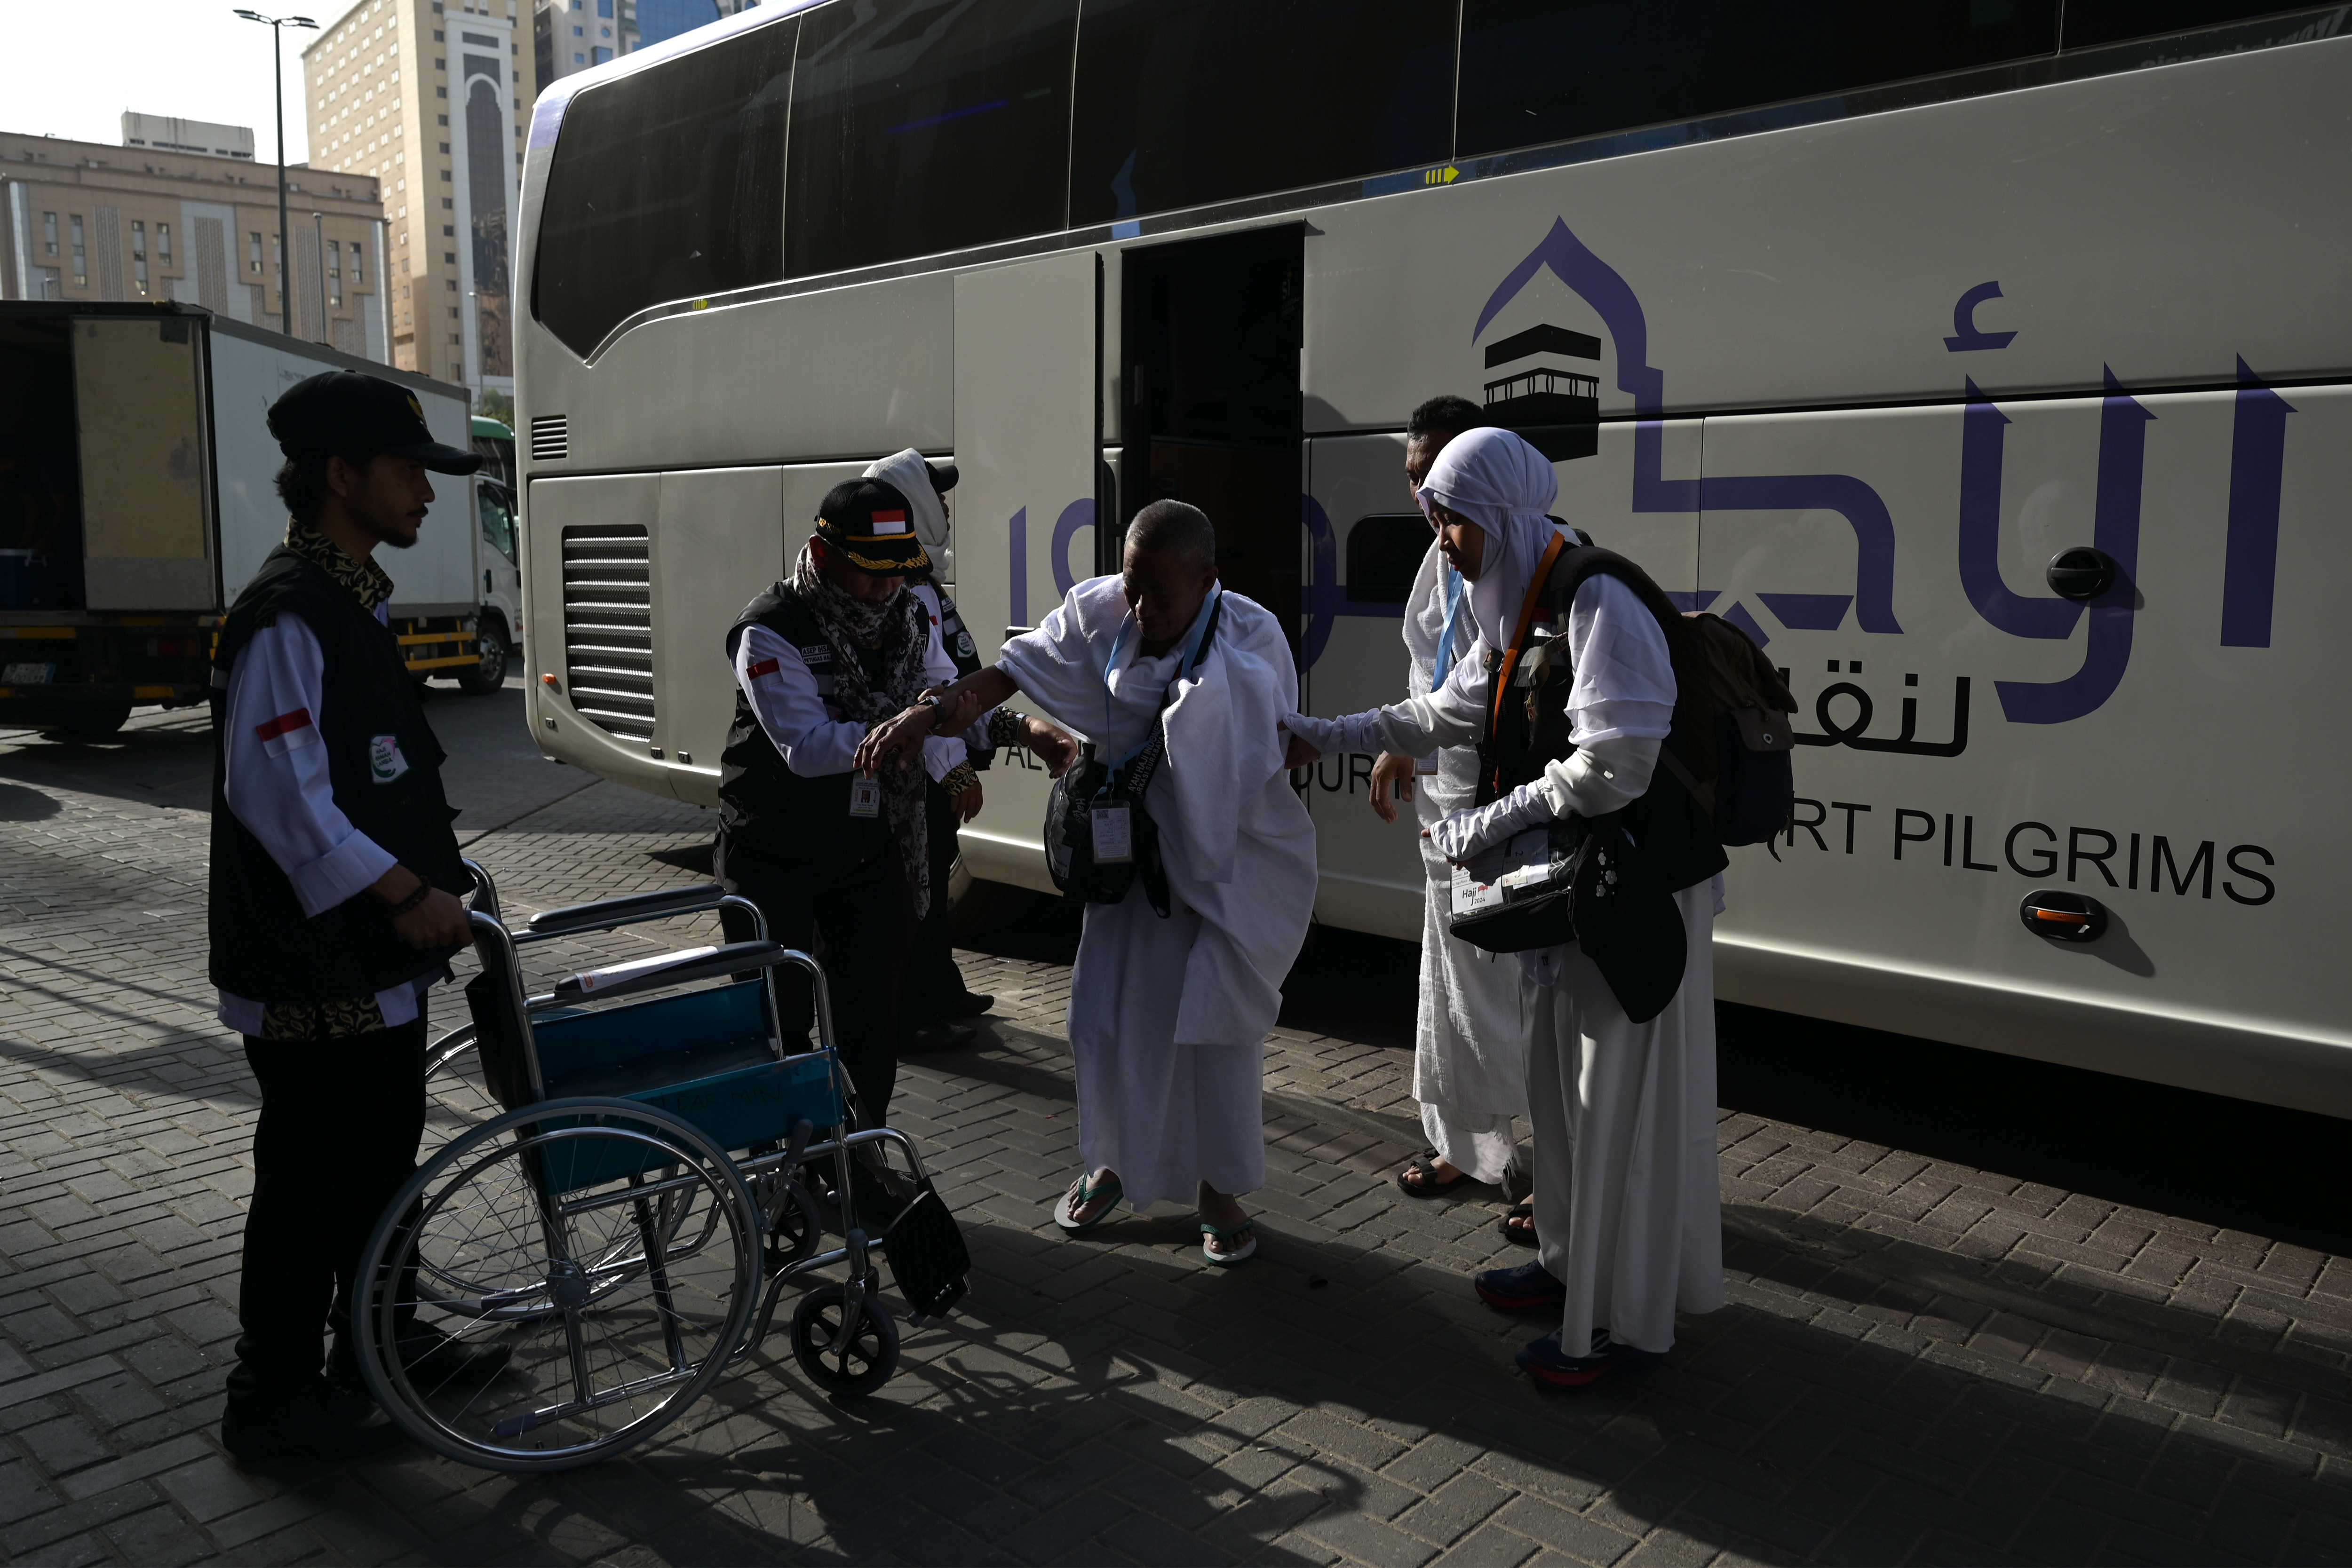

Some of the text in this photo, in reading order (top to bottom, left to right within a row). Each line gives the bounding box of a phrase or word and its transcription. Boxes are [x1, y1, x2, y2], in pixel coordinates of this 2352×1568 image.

[377, 758, 393, 767] LANSIA
[1146, 736, 1164, 771] SURABAYA
[1136, 755, 1149, 774] HAJI
[1893, 808, 2275, 906] PILGRIMS
[1462, 887, 1477, 906] Haji
